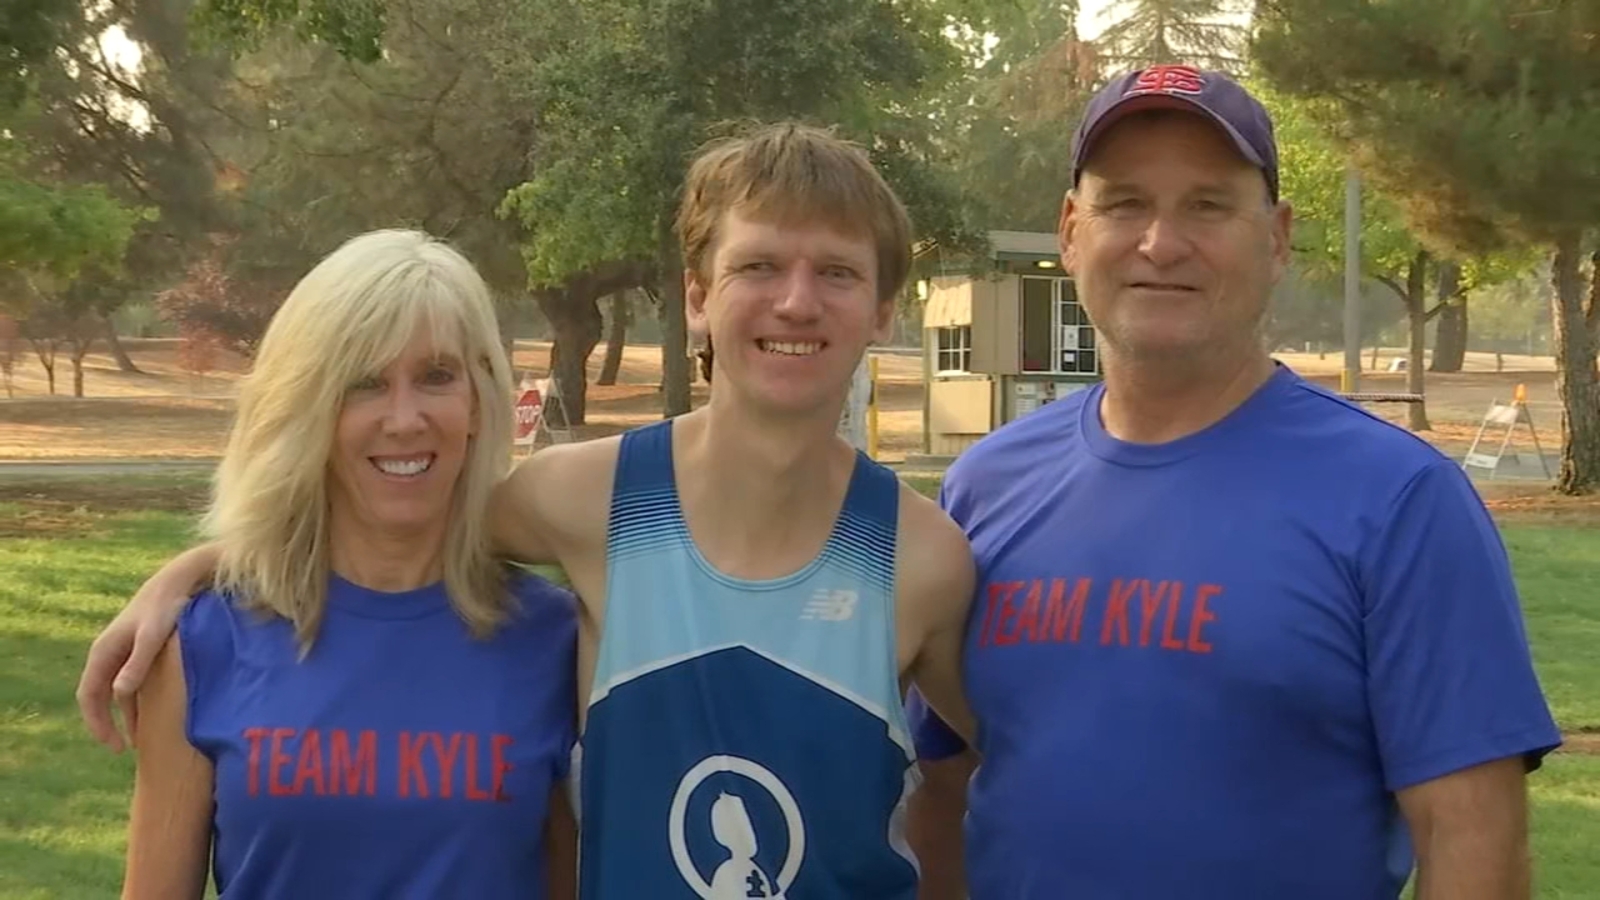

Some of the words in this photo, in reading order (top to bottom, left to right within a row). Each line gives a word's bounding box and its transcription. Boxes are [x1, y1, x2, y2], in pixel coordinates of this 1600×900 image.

[515, 405, 541, 424] STOP
[979, 577, 1092, 648] TEAM
[1100, 577, 1222, 653] KYLE
[243, 726, 377, 796] TEAM
[397, 731, 515, 801] KYLE
